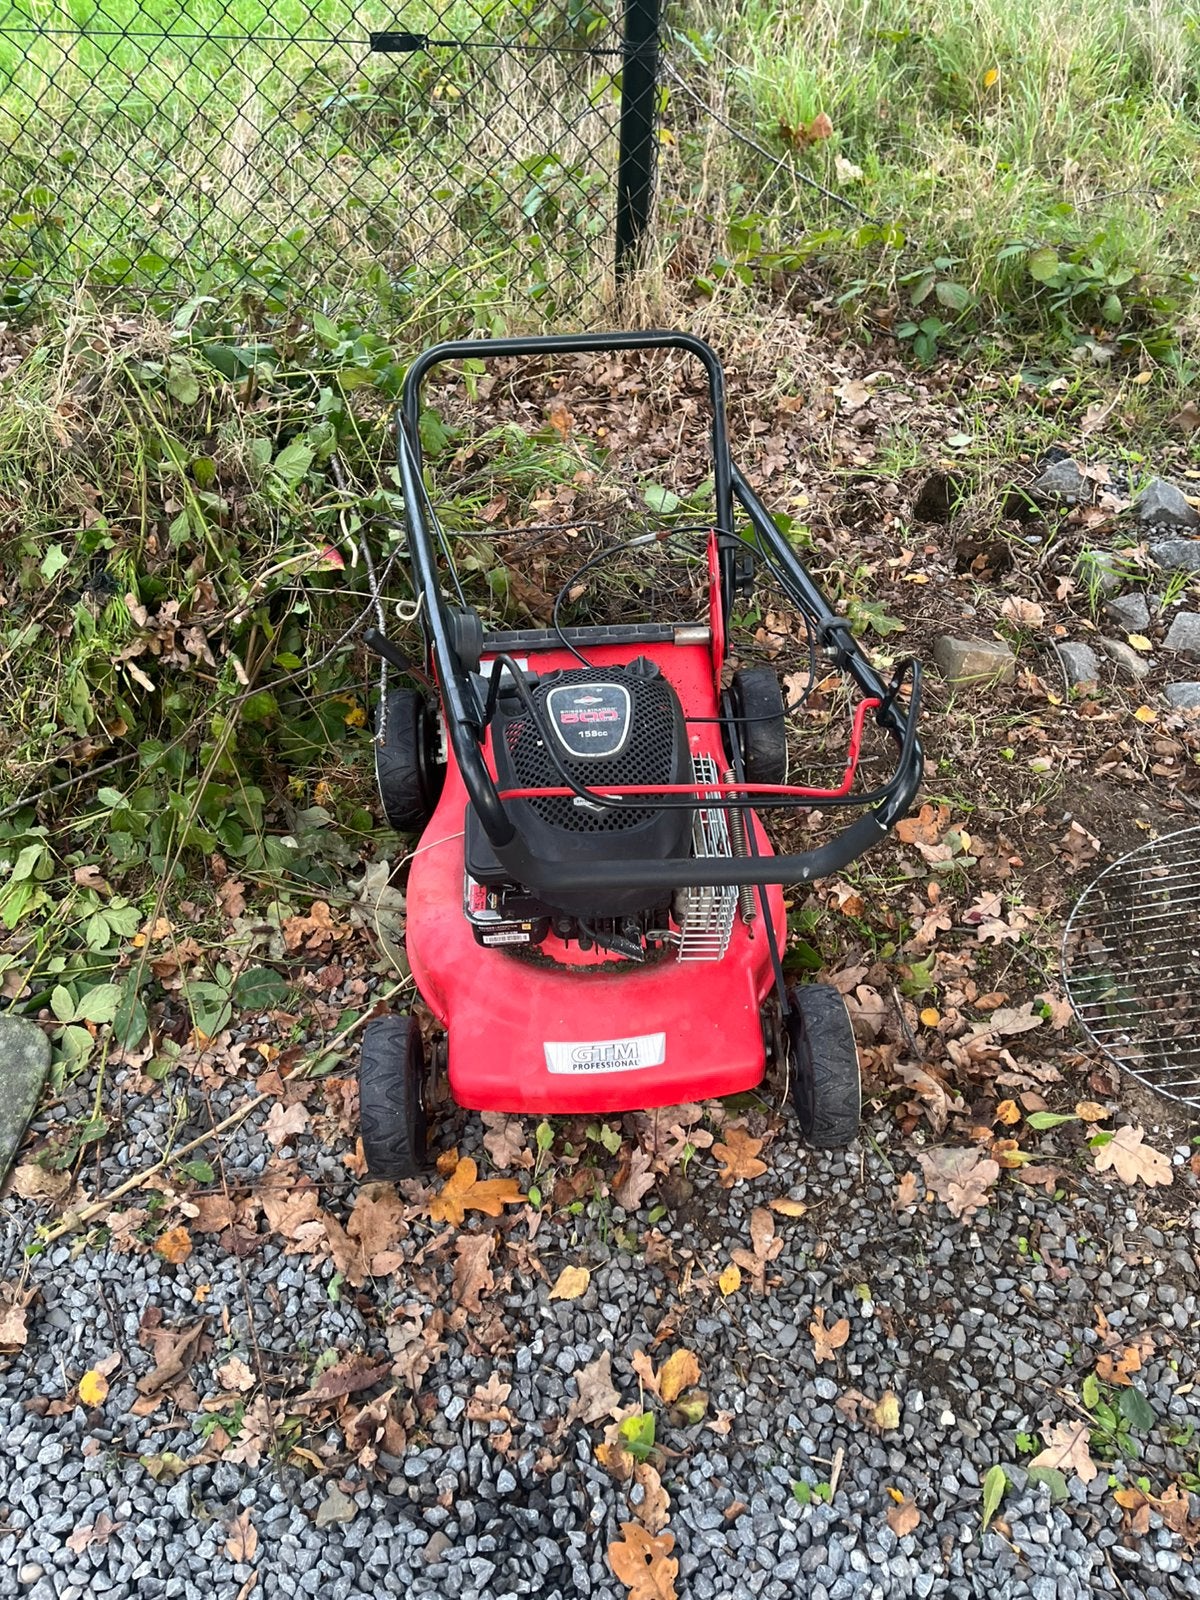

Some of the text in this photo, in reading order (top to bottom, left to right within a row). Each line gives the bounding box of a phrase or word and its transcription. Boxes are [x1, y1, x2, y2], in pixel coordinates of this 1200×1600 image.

[561, 711, 618, 723] 500
[578, 730, 608, 738] 158cc
[572, 1043, 638, 1063] GTM
[573, 1060, 639, 1071] PROFESSIONAL
